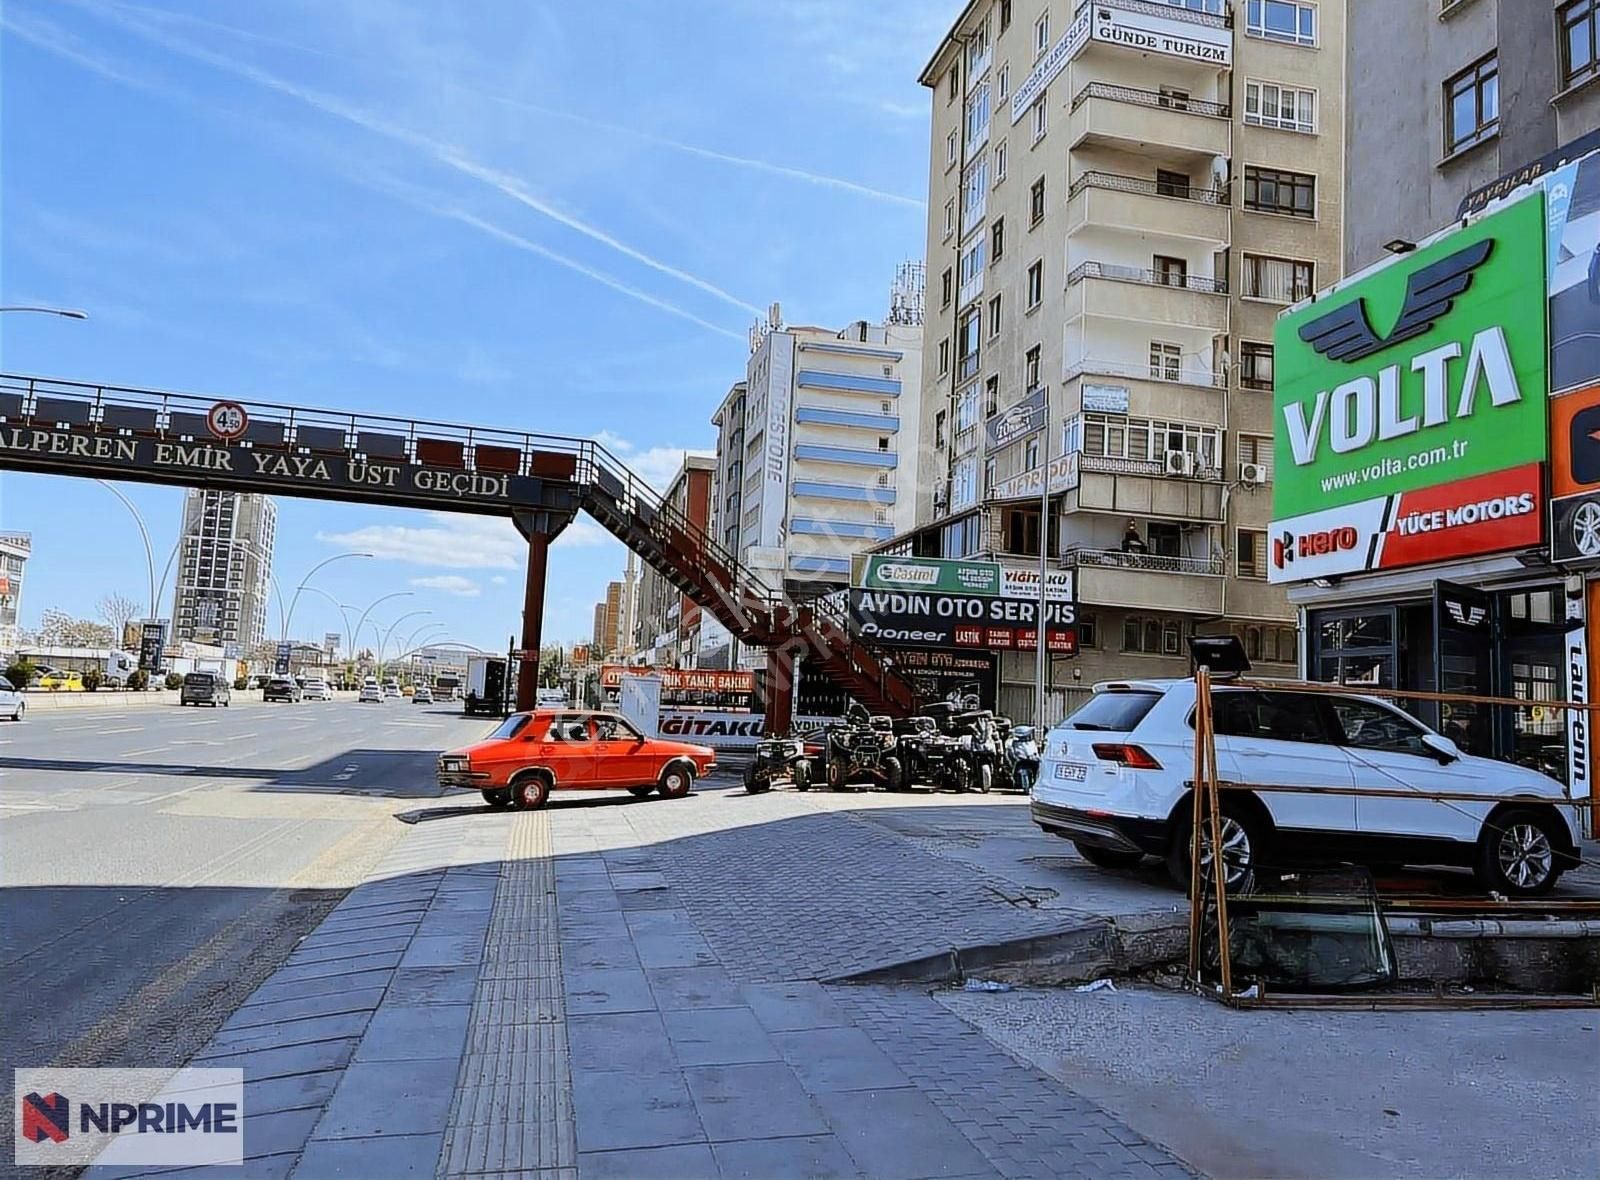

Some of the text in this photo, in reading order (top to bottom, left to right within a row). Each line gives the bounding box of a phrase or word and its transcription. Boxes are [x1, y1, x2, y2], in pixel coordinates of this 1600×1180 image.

[1099, 25, 1226, 61] GÜNDE TURİZM
[1283, 326, 1521, 467] VOLTA
[154, 443, 234, 471] EMİR
[253, 453, 331, 481] YAYA
[348, 461, 401, 487] ÜST
[414, 470, 509, 498] GEÇİDİ
[1320, 439, 1469, 493] www.volta.com.tr
[1396, 491, 1534, 537] YÜCE MOTORS
[859, 592, 931, 616] AYDIN
[936, 597, 984, 619] OTO
[858, 623, 947, 642] Pioneer
[685, 673, 716, 688] TAMİR
[718, 676, 750, 689] BAKIM
